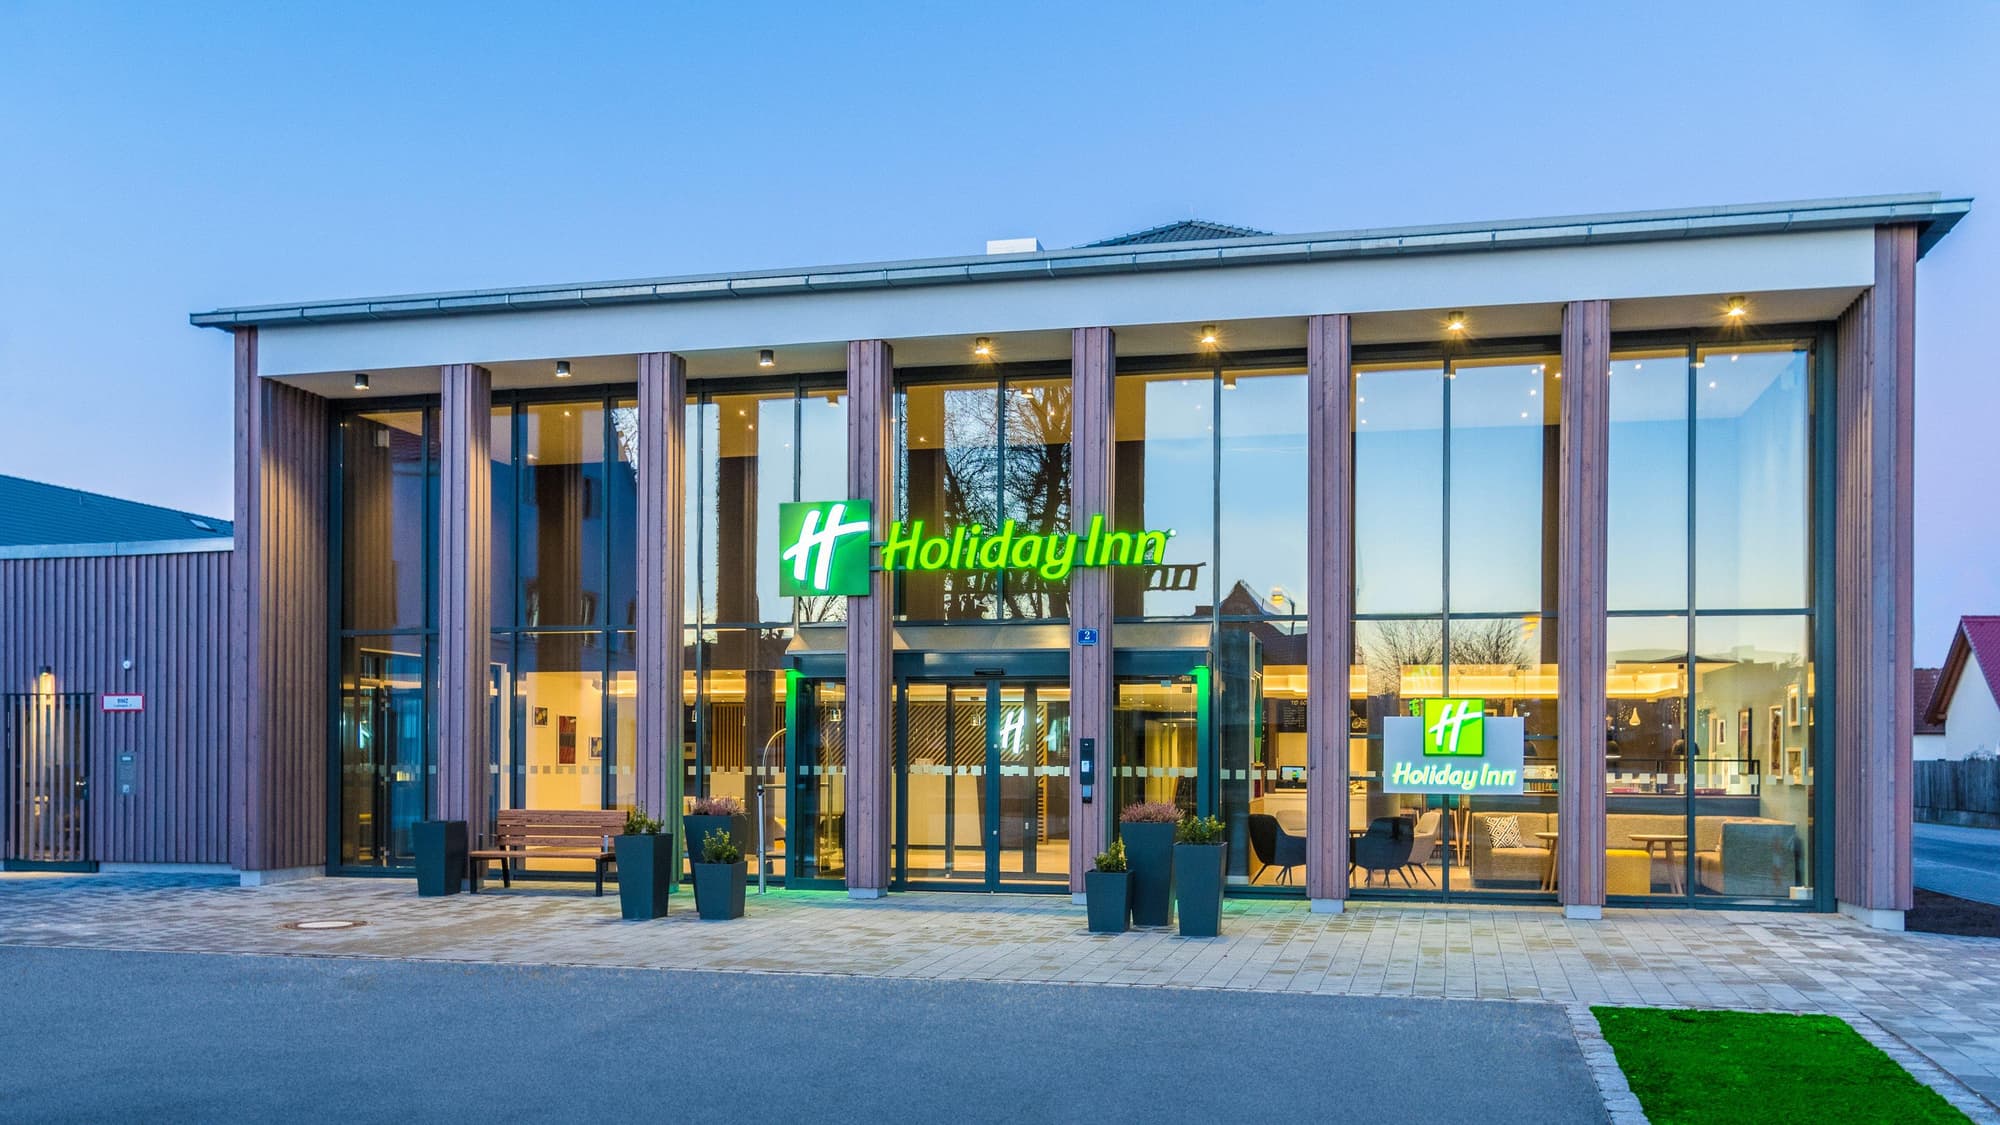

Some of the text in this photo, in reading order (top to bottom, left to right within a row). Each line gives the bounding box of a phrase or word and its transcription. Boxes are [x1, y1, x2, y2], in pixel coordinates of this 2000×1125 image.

[881, 518, 1077, 580] Holiday
[1085, 514, 1167, 566] Inn
[1084, 630, 1091, 640] 2
[1391, 761, 1517, 791] Holiday Inn
